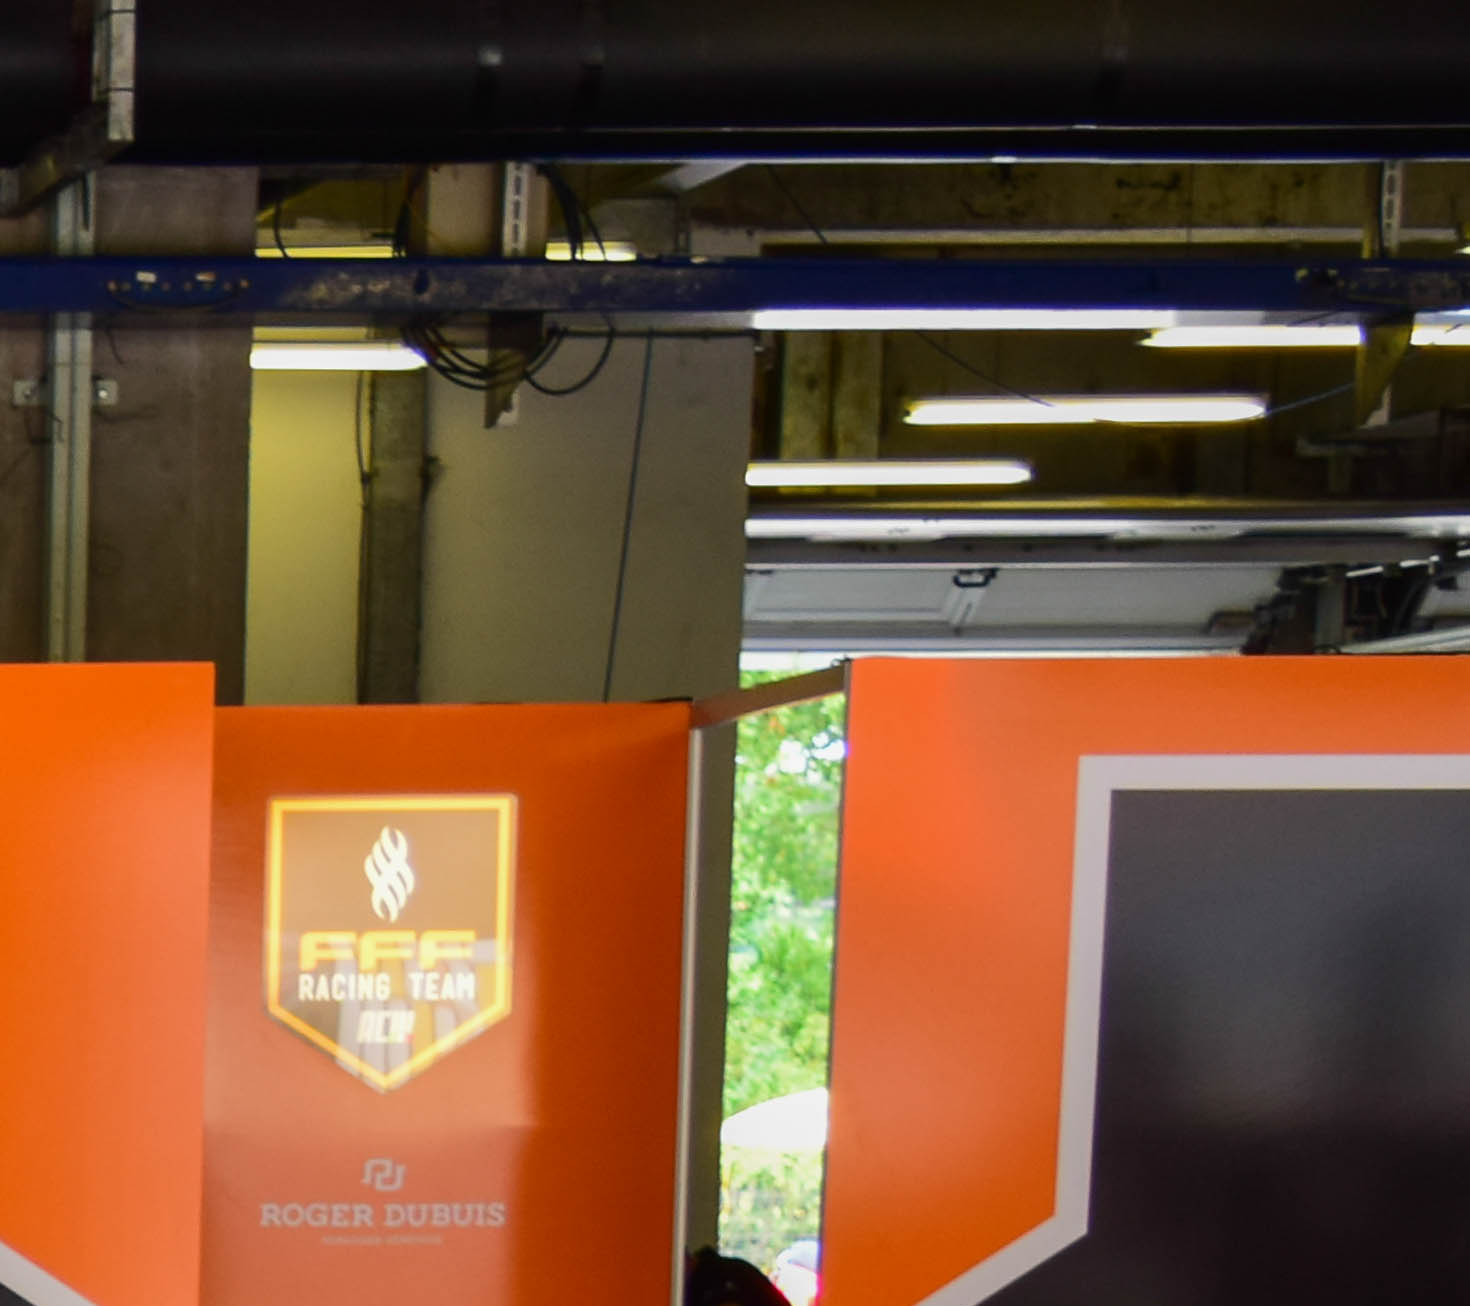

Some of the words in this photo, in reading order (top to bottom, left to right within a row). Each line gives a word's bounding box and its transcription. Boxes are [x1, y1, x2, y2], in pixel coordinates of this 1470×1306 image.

[298, 972, 391, 1001] RACING
[408, 971, 476, 1001] TEAM
[259, 1202, 374, 1228] ROGER
[383, 1202, 507, 1228] DUBUIS
